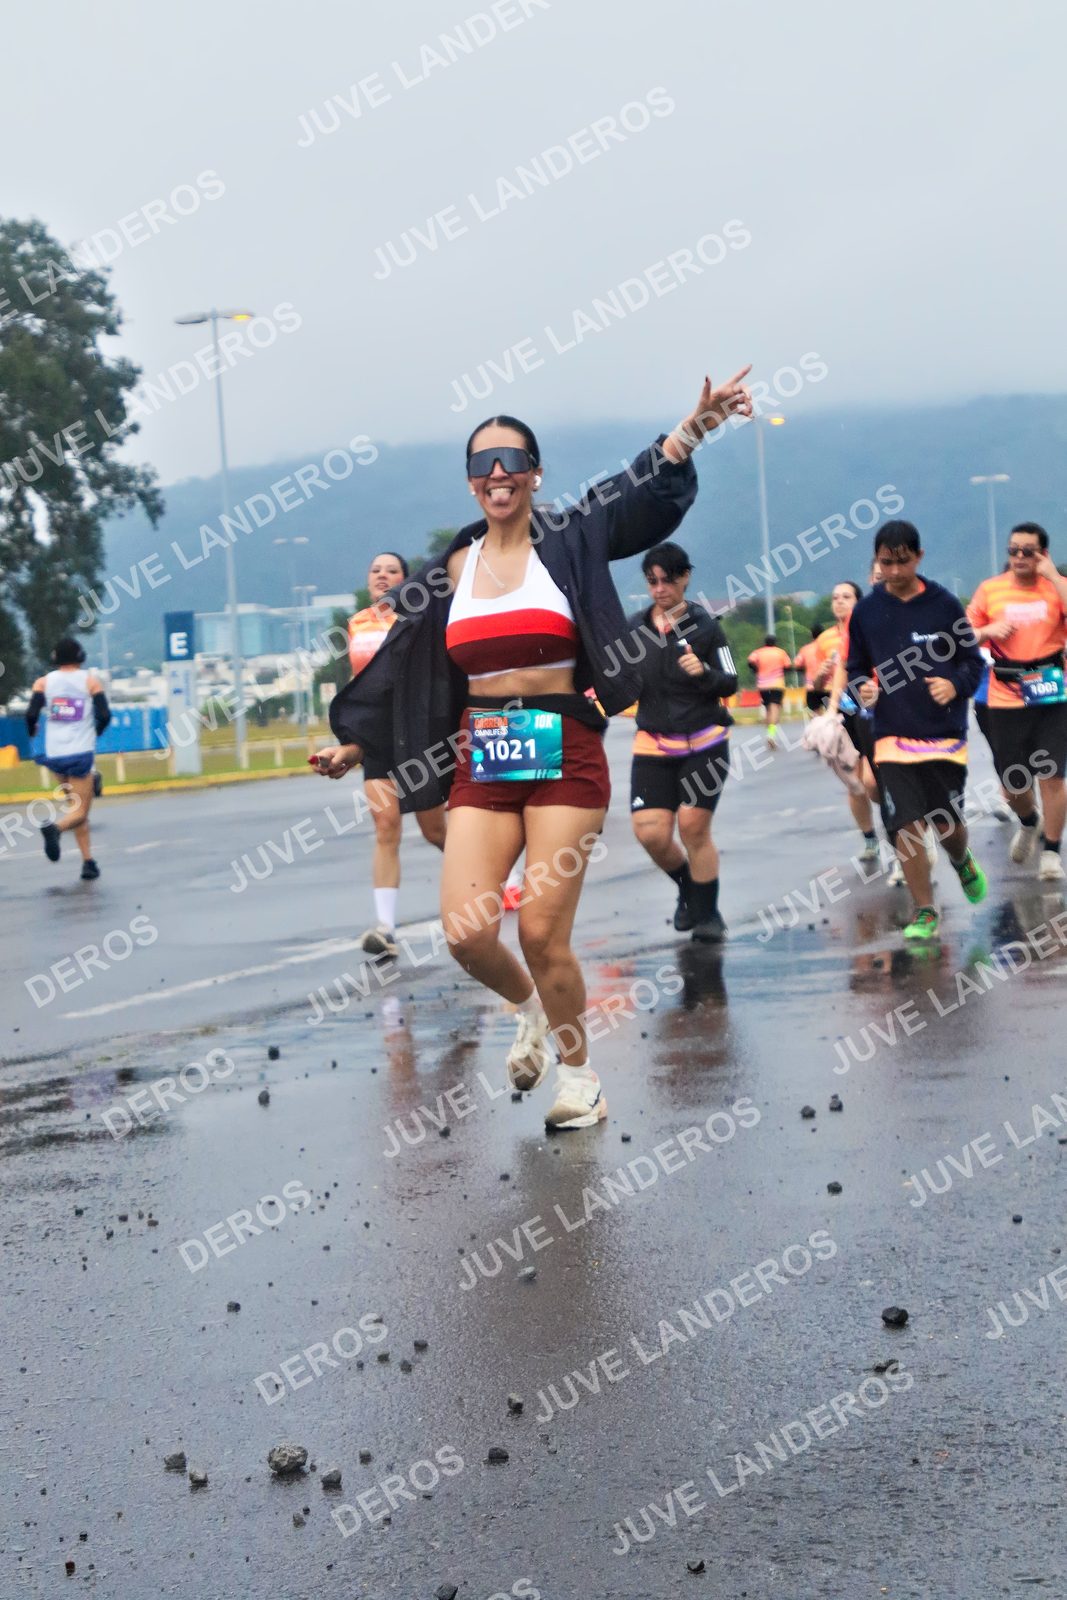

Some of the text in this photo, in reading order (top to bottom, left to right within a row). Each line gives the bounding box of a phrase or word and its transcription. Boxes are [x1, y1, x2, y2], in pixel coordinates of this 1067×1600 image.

[170, 632, 189, 656] E
[535, 714, 553, 729] 10K
[485, 738, 536, 761] 1021
